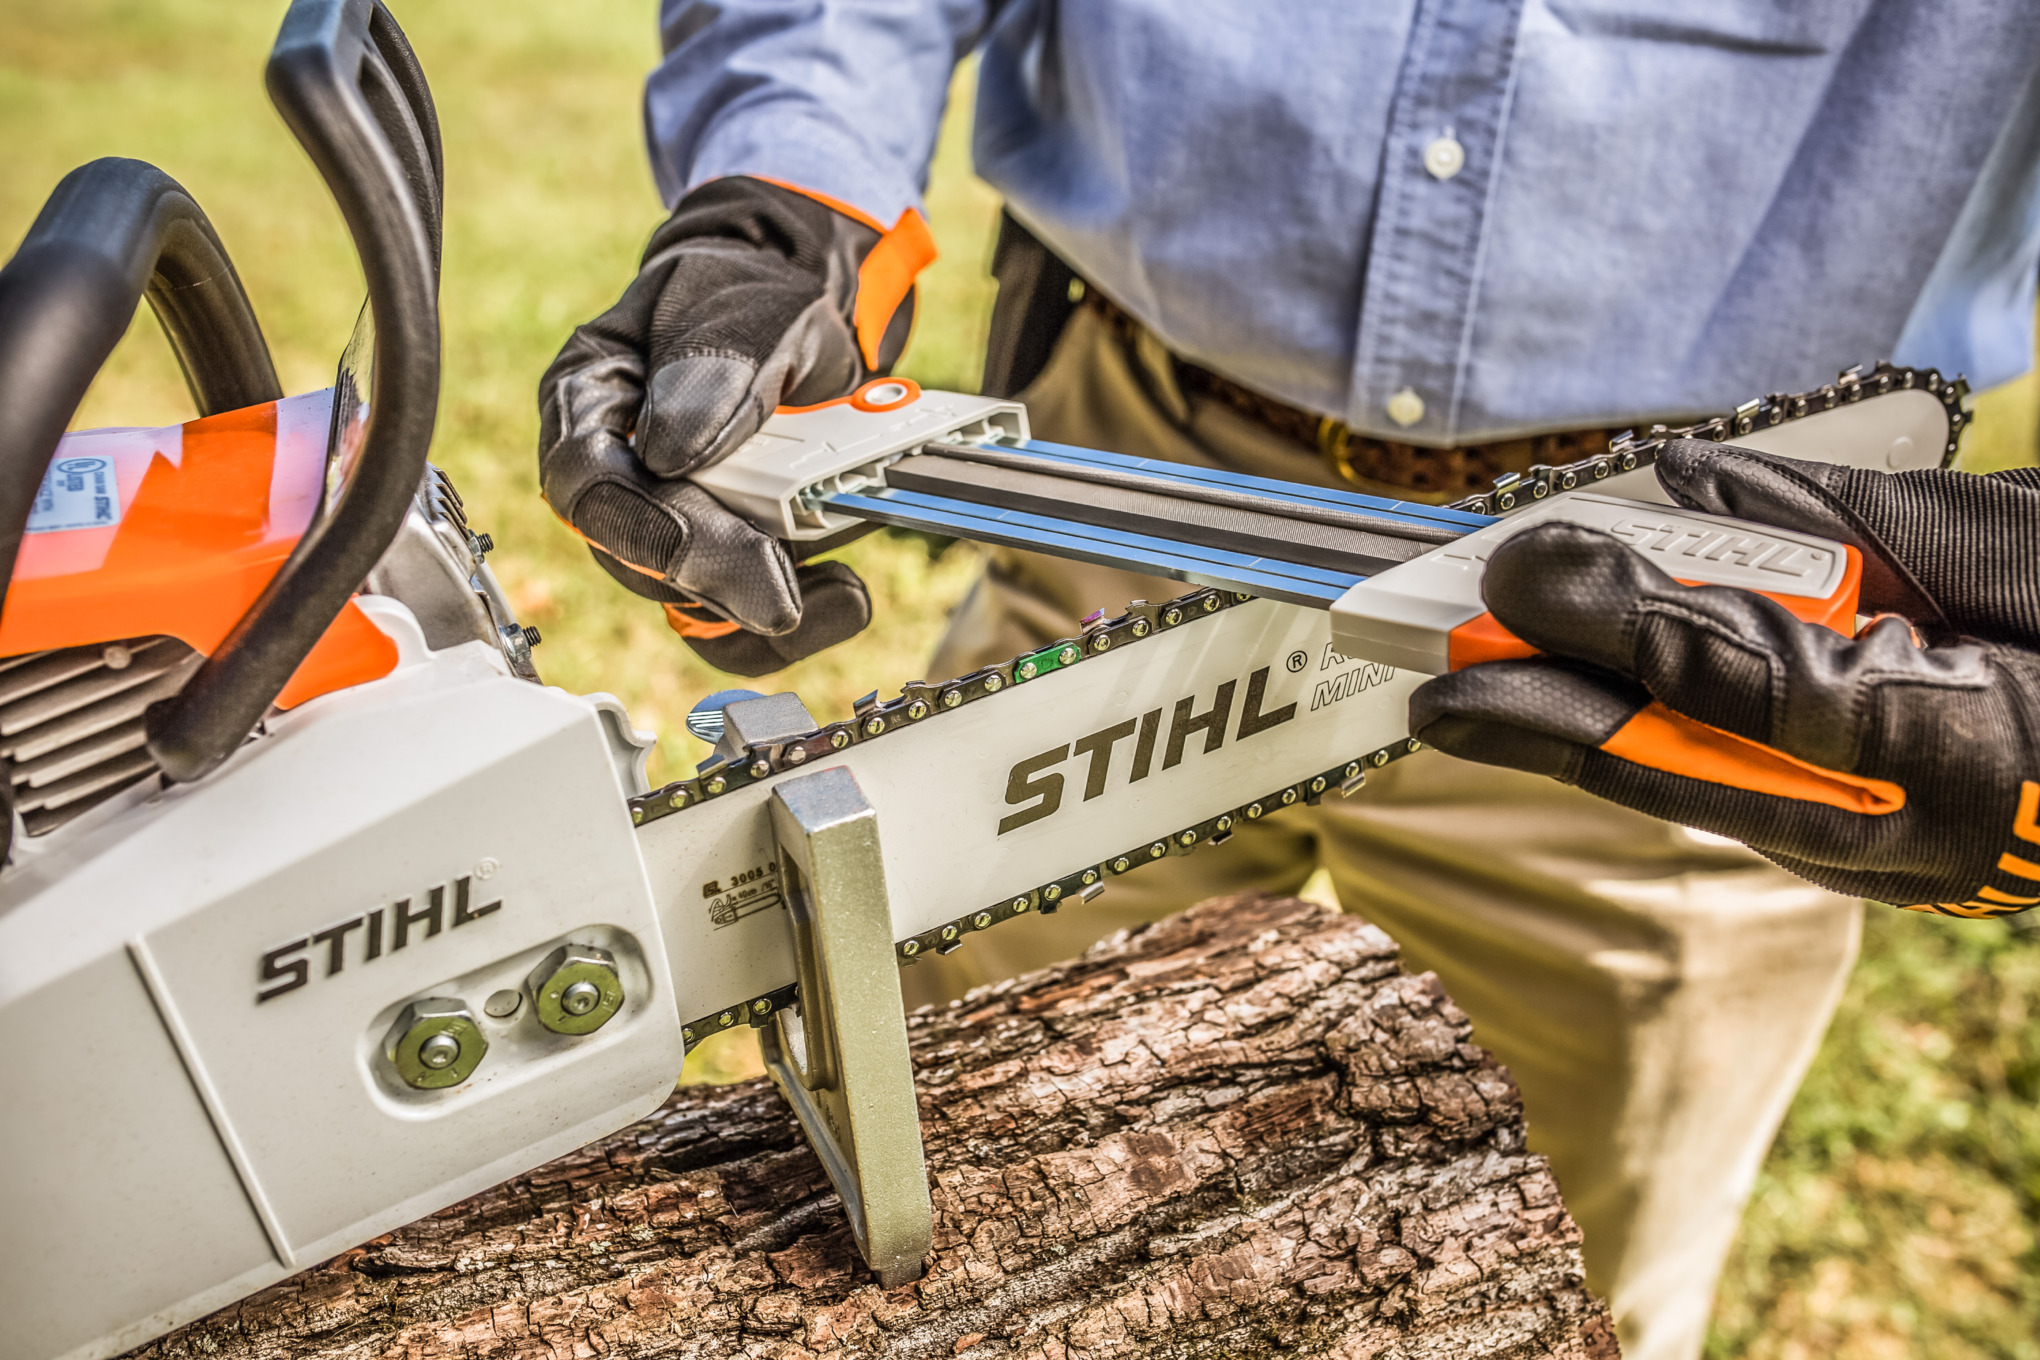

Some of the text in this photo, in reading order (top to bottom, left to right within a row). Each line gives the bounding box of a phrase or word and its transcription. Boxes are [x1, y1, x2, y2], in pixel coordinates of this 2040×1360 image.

[1611, 518, 1813, 577] STIHL
[997, 665, 1299, 837] STIHL
[255, 872, 503, 1004] STIHL
